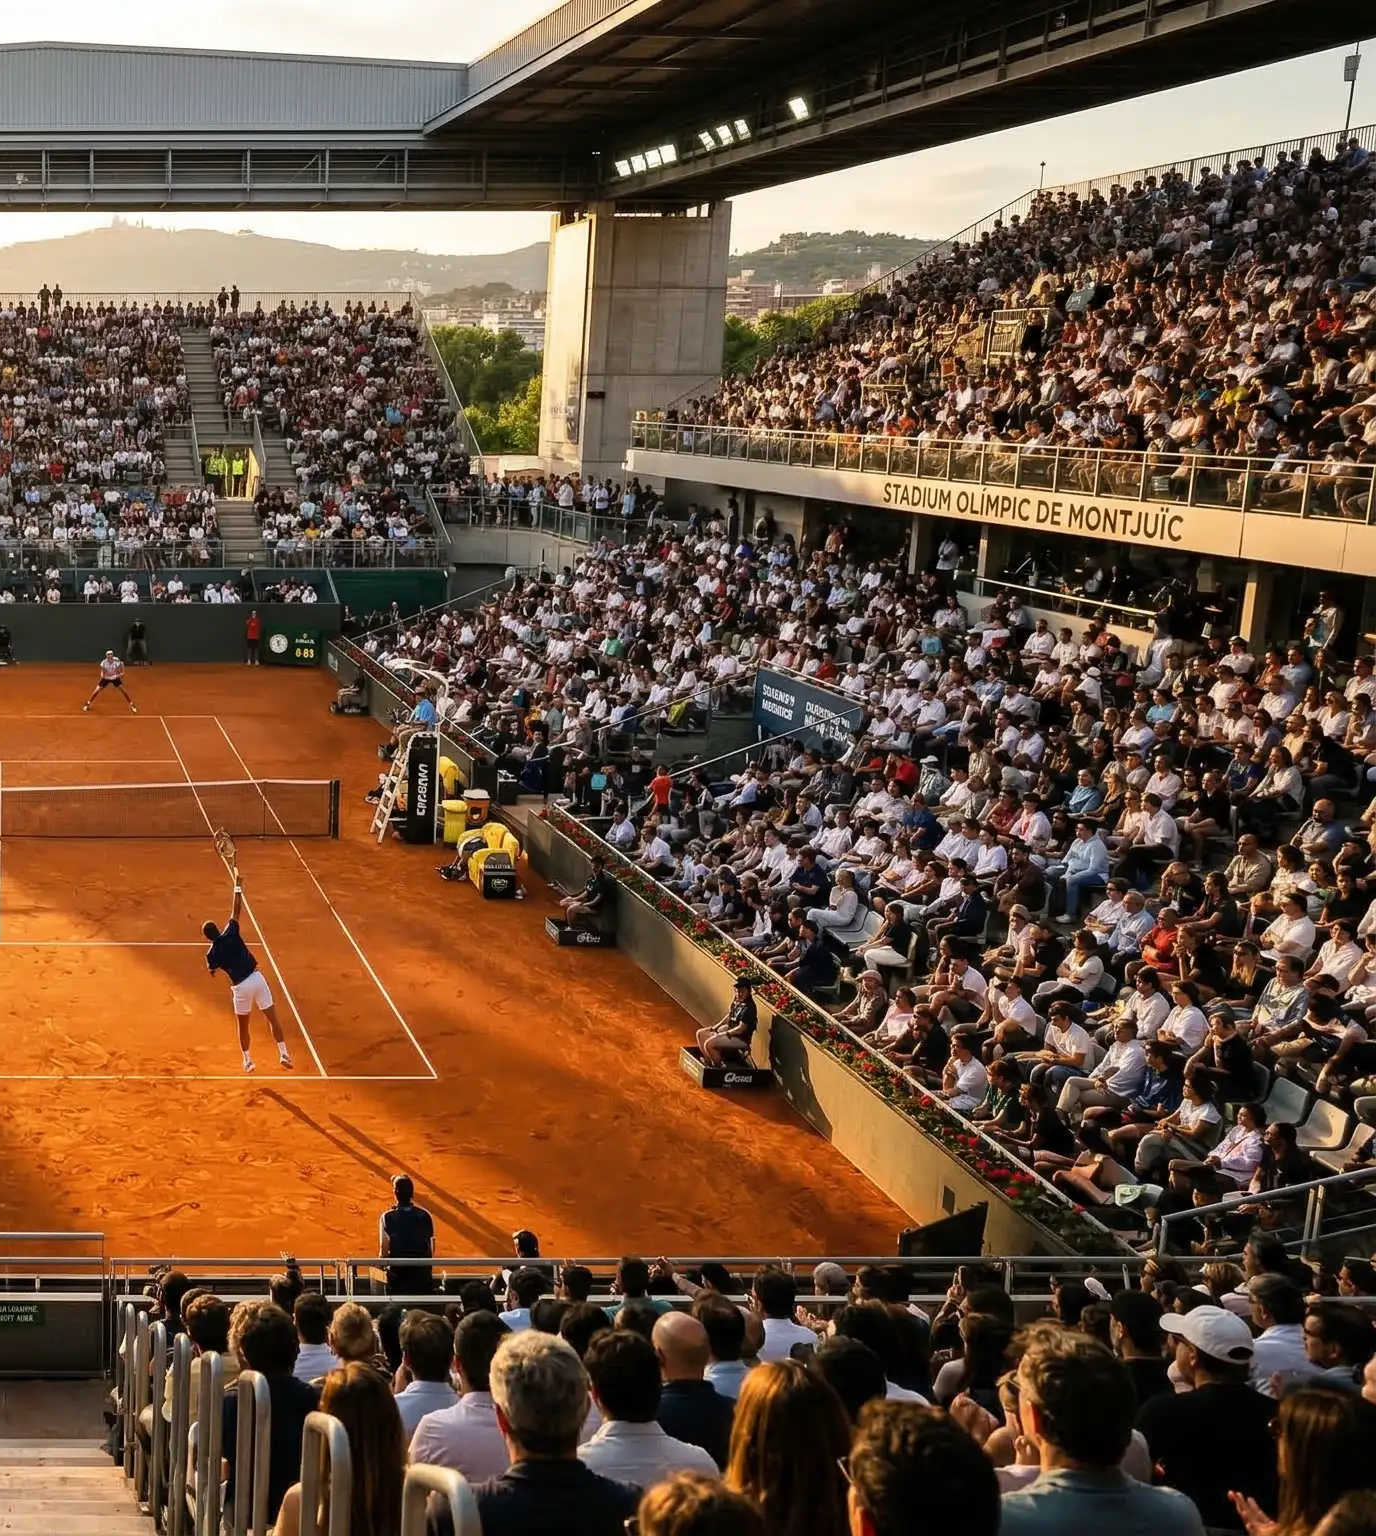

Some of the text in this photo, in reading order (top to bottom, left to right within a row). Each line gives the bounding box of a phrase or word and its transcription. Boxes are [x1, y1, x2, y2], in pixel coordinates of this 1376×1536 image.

[883, 482, 1184, 542] STADIUM OLÍMPIC DE MONTJUÏC
